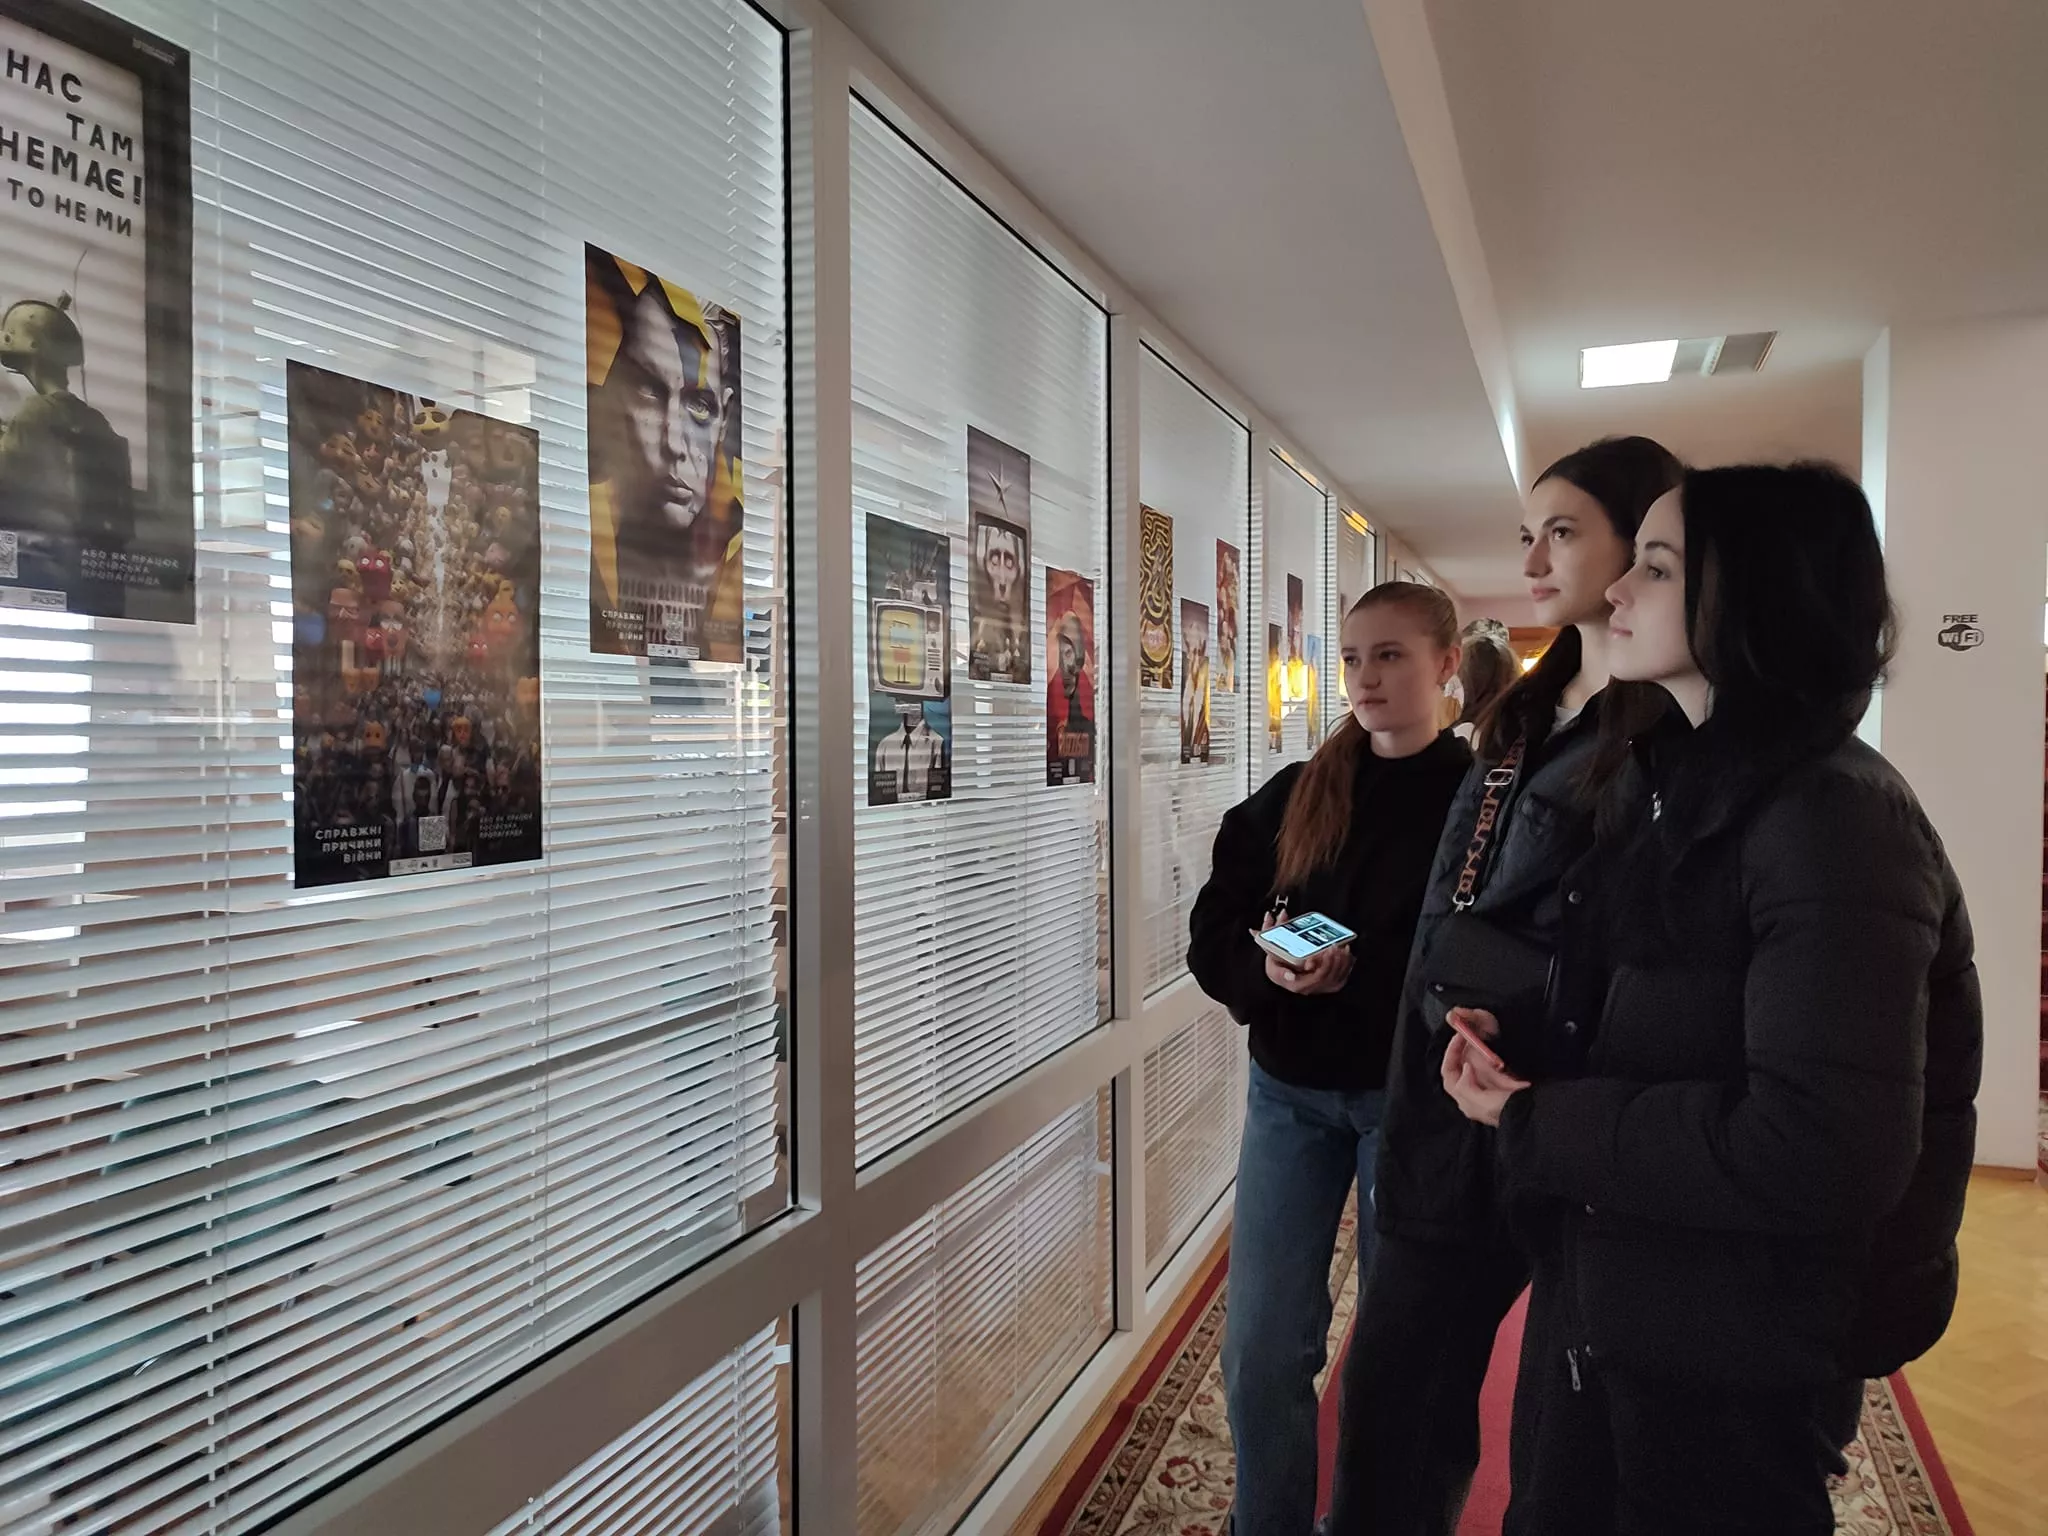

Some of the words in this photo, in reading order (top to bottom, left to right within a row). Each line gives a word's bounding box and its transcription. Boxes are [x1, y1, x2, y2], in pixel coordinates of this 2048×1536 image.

[6, 48, 83, 104] НАС
[66, 112, 134, 162] ТАМ
[0, 125, 143, 206] НЕМАЄ!
[7, 177, 45, 208] ТО
[55, 193, 87, 224] НЕ
[96, 207, 132, 238] МИ
[1943, 614, 1978, 624] FREE
[315, 826, 382, 840] СПРАВЖНІ
[322, 838, 382, 852] ПРИЧИНИ
[343, 850, 382, 863] ВІЙНИ
